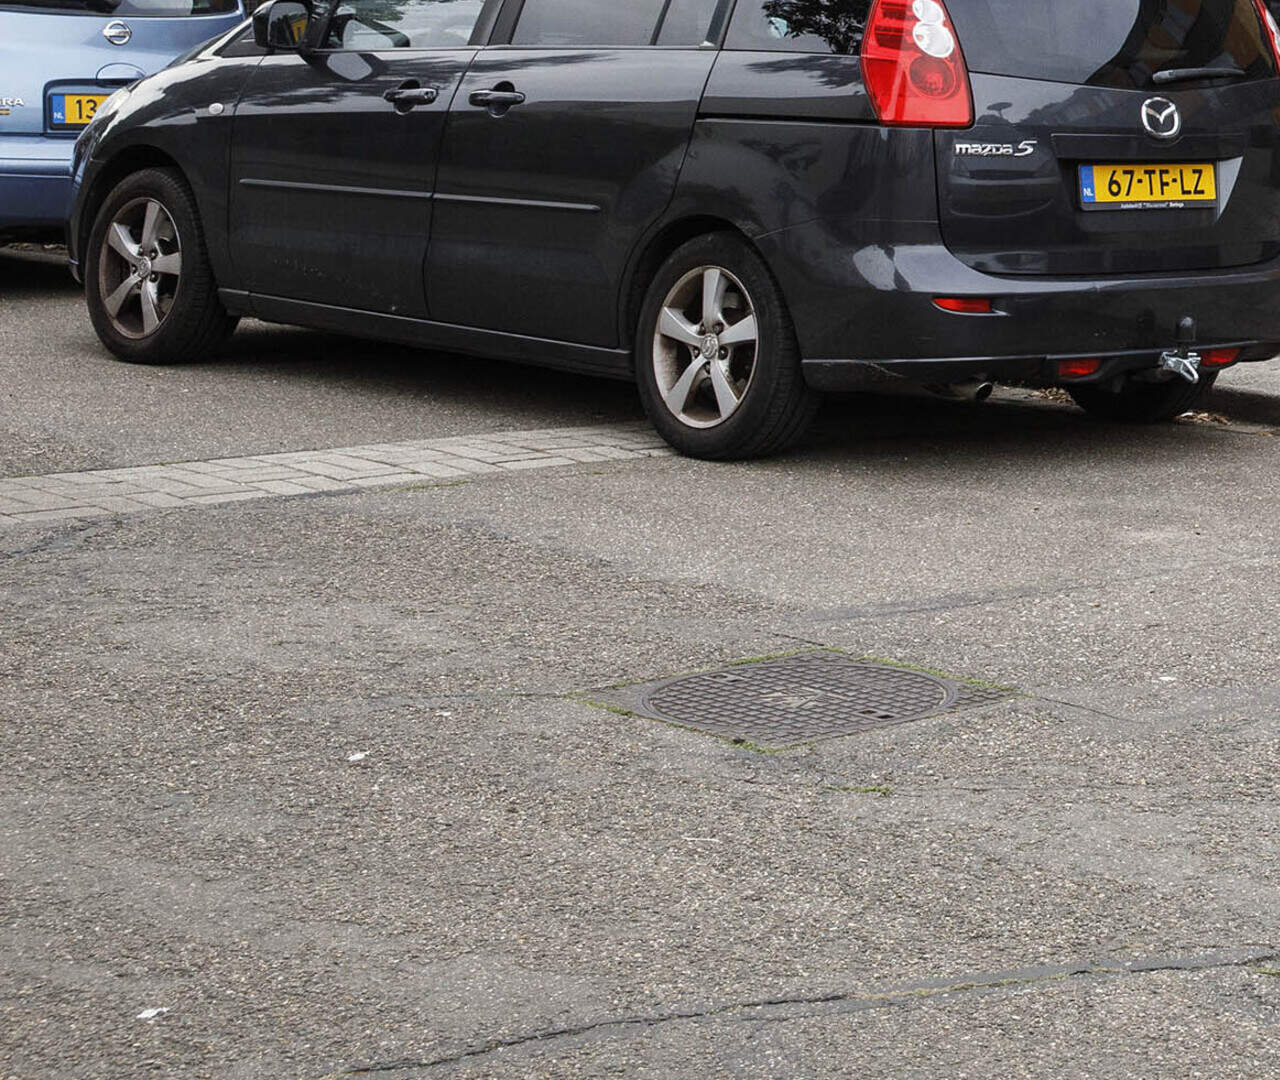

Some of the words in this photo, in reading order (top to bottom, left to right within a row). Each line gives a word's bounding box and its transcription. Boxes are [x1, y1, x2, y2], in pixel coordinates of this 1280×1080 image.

[75, 98, 98, 120] 13
[1083, 187, 1094, 197] NL
[1107, 168, 1206, 197] 67-TF-LZ
